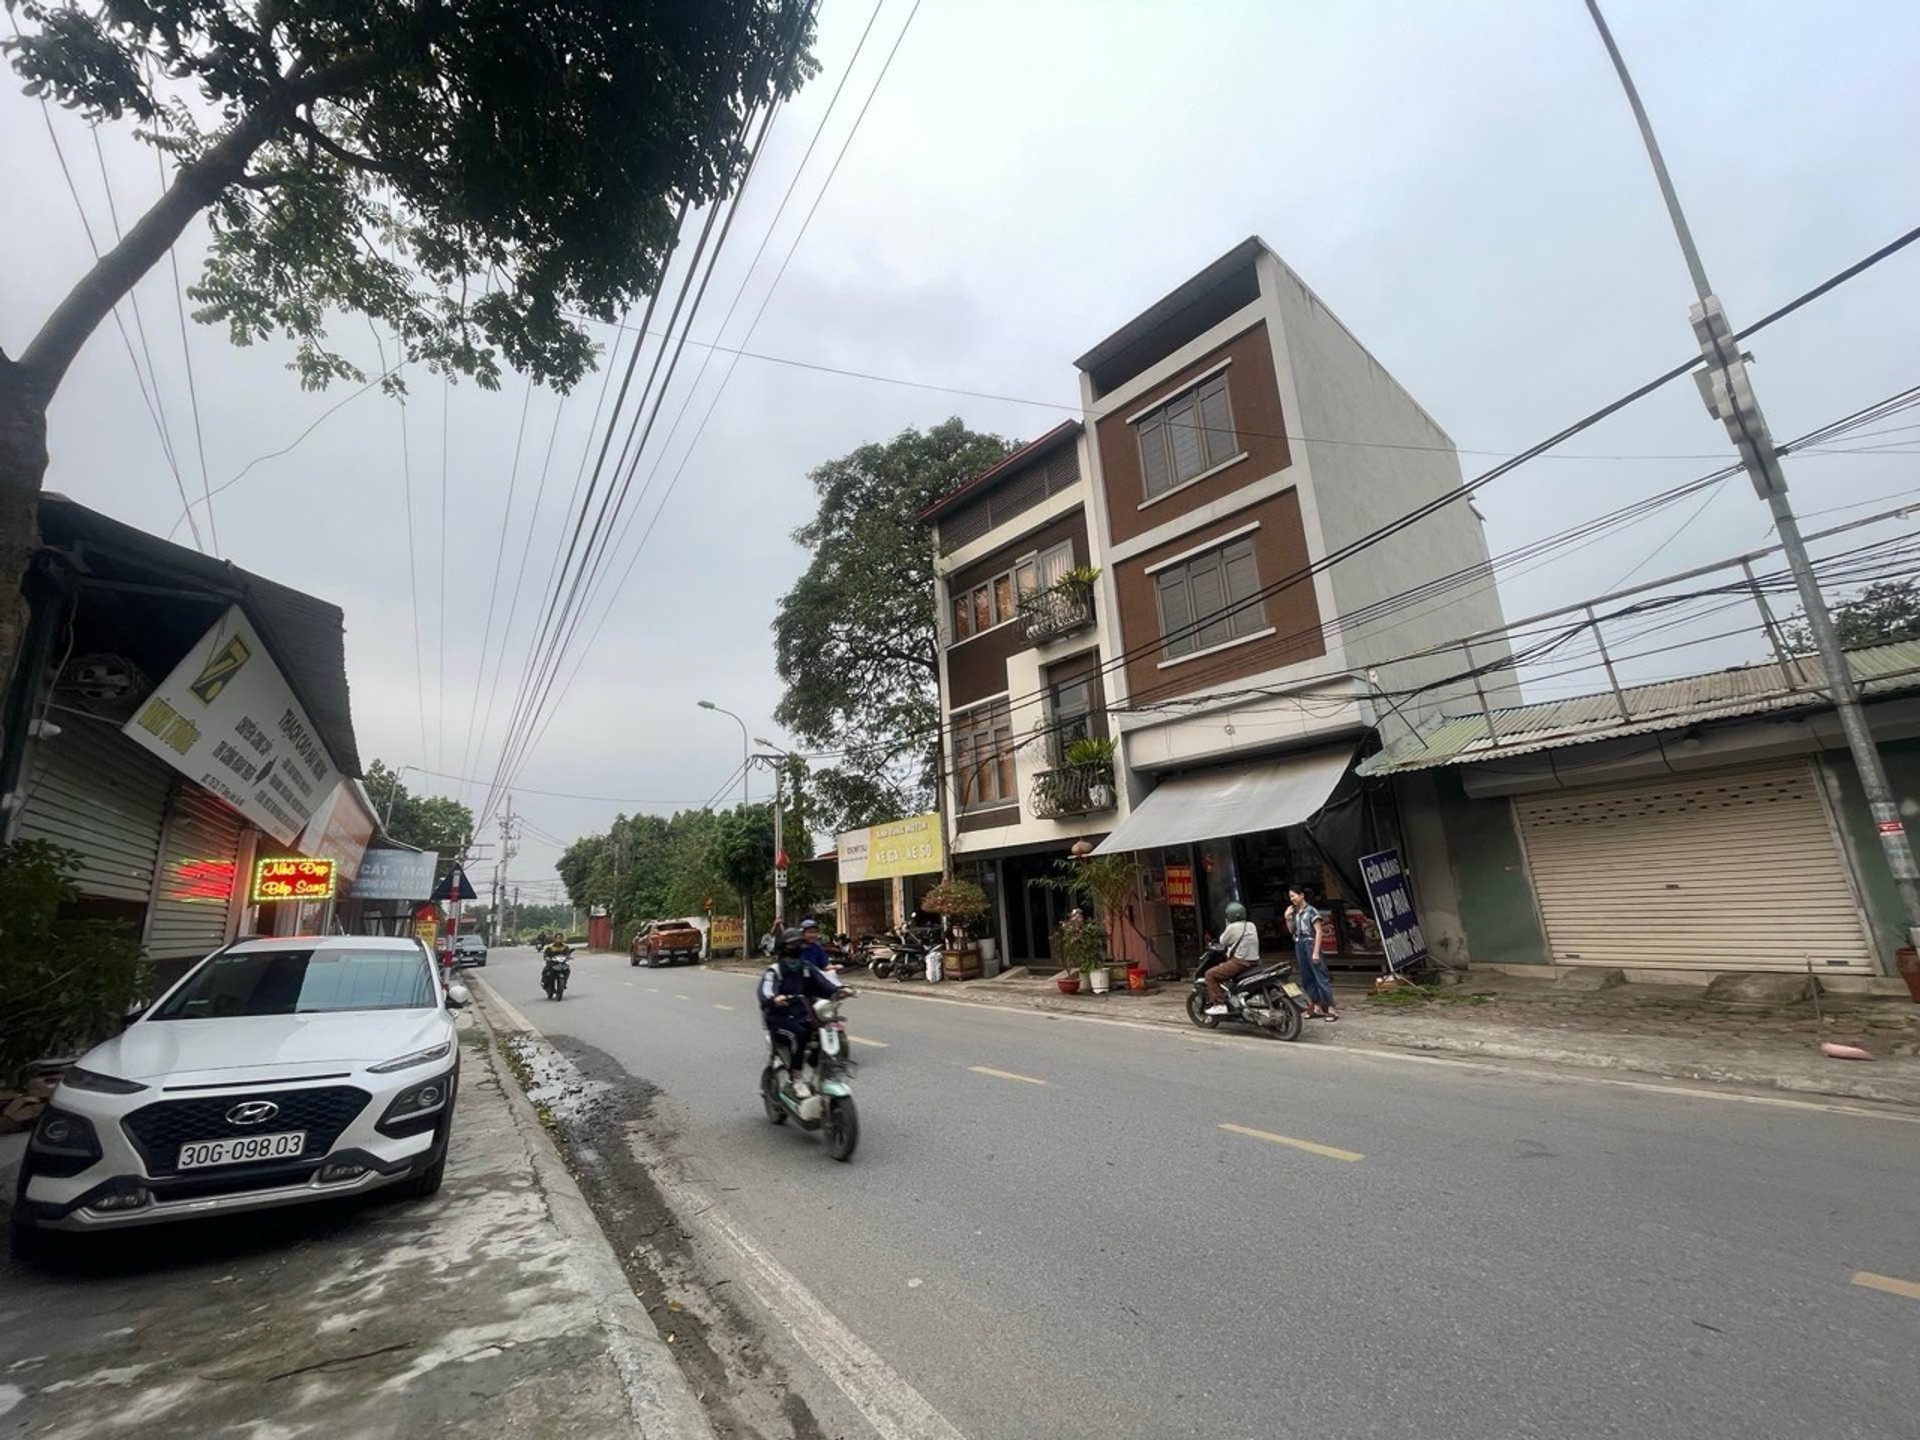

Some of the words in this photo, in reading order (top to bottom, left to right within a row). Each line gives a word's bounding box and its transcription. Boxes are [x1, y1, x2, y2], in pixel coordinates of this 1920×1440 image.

[277, 707, 303, 745] THẠCH
[295, 733, 312, 757] CAO
[182, 1134, 302, 1166] 30G-098.03
